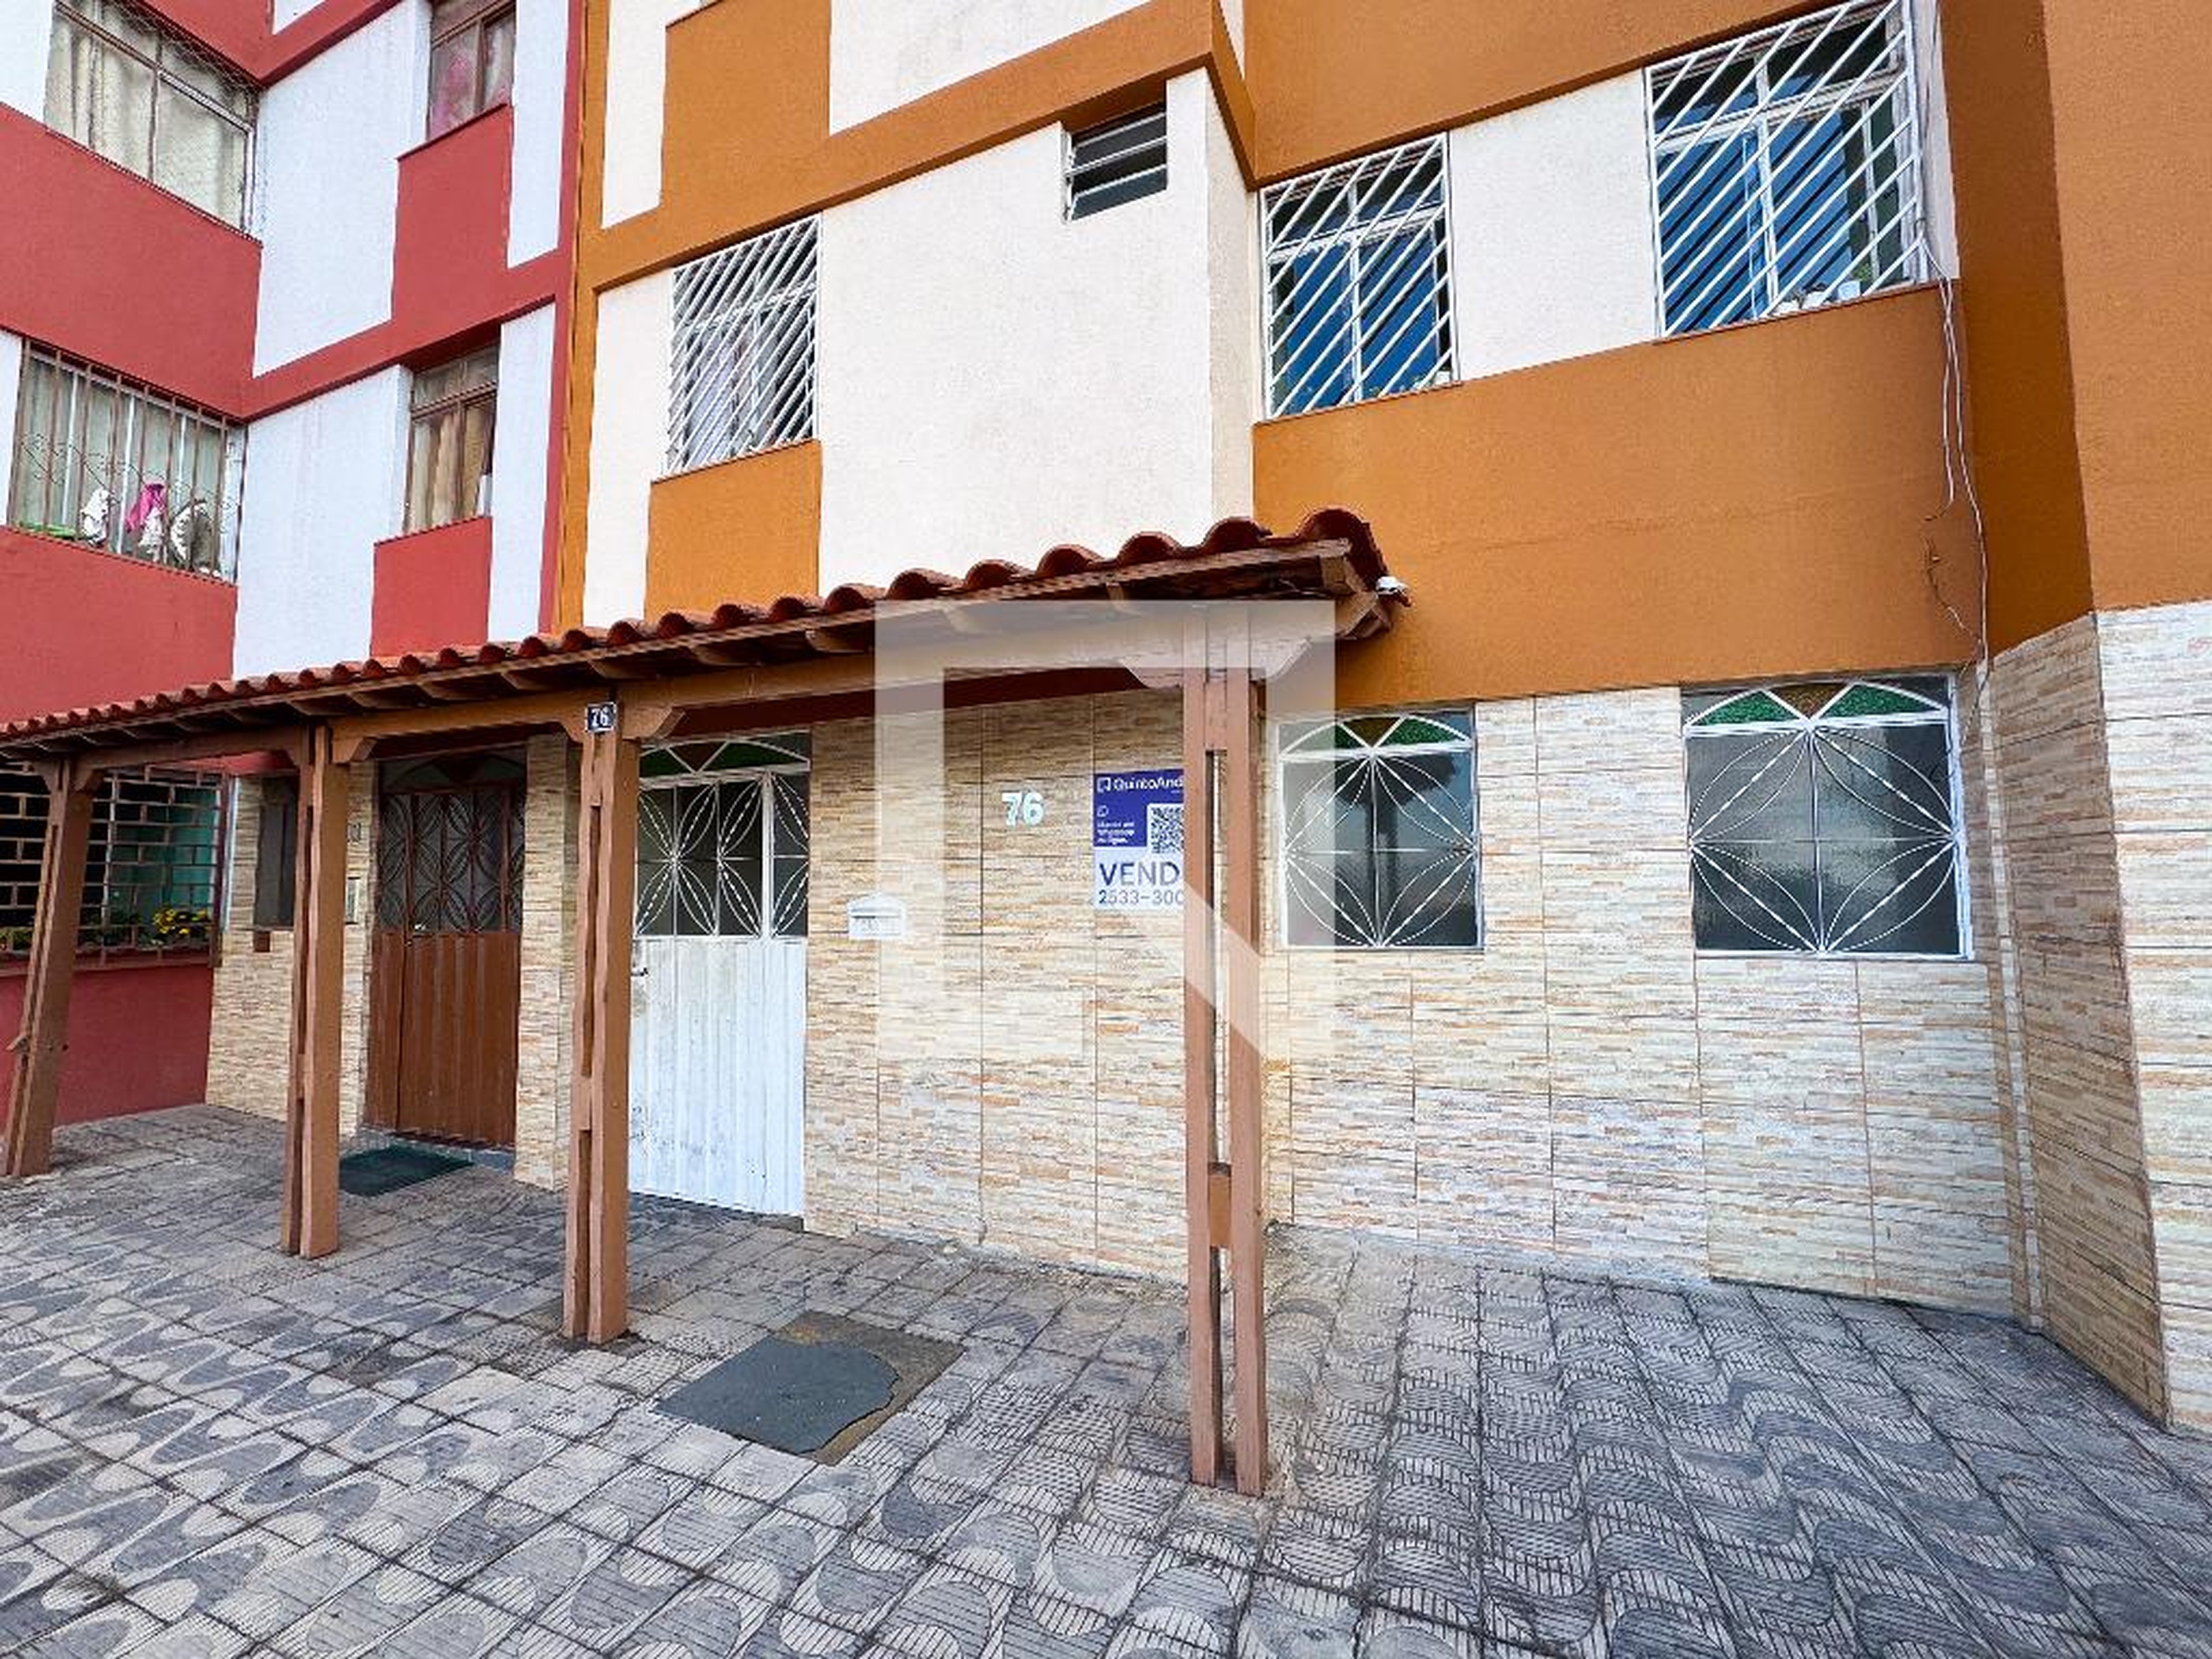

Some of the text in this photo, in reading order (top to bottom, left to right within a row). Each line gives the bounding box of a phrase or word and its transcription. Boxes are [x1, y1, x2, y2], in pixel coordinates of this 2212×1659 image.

[592, 707, 609, 726] 76
[1001, 791, 1044, 826] 76
[1099, 862, 1180, 885] VEND
